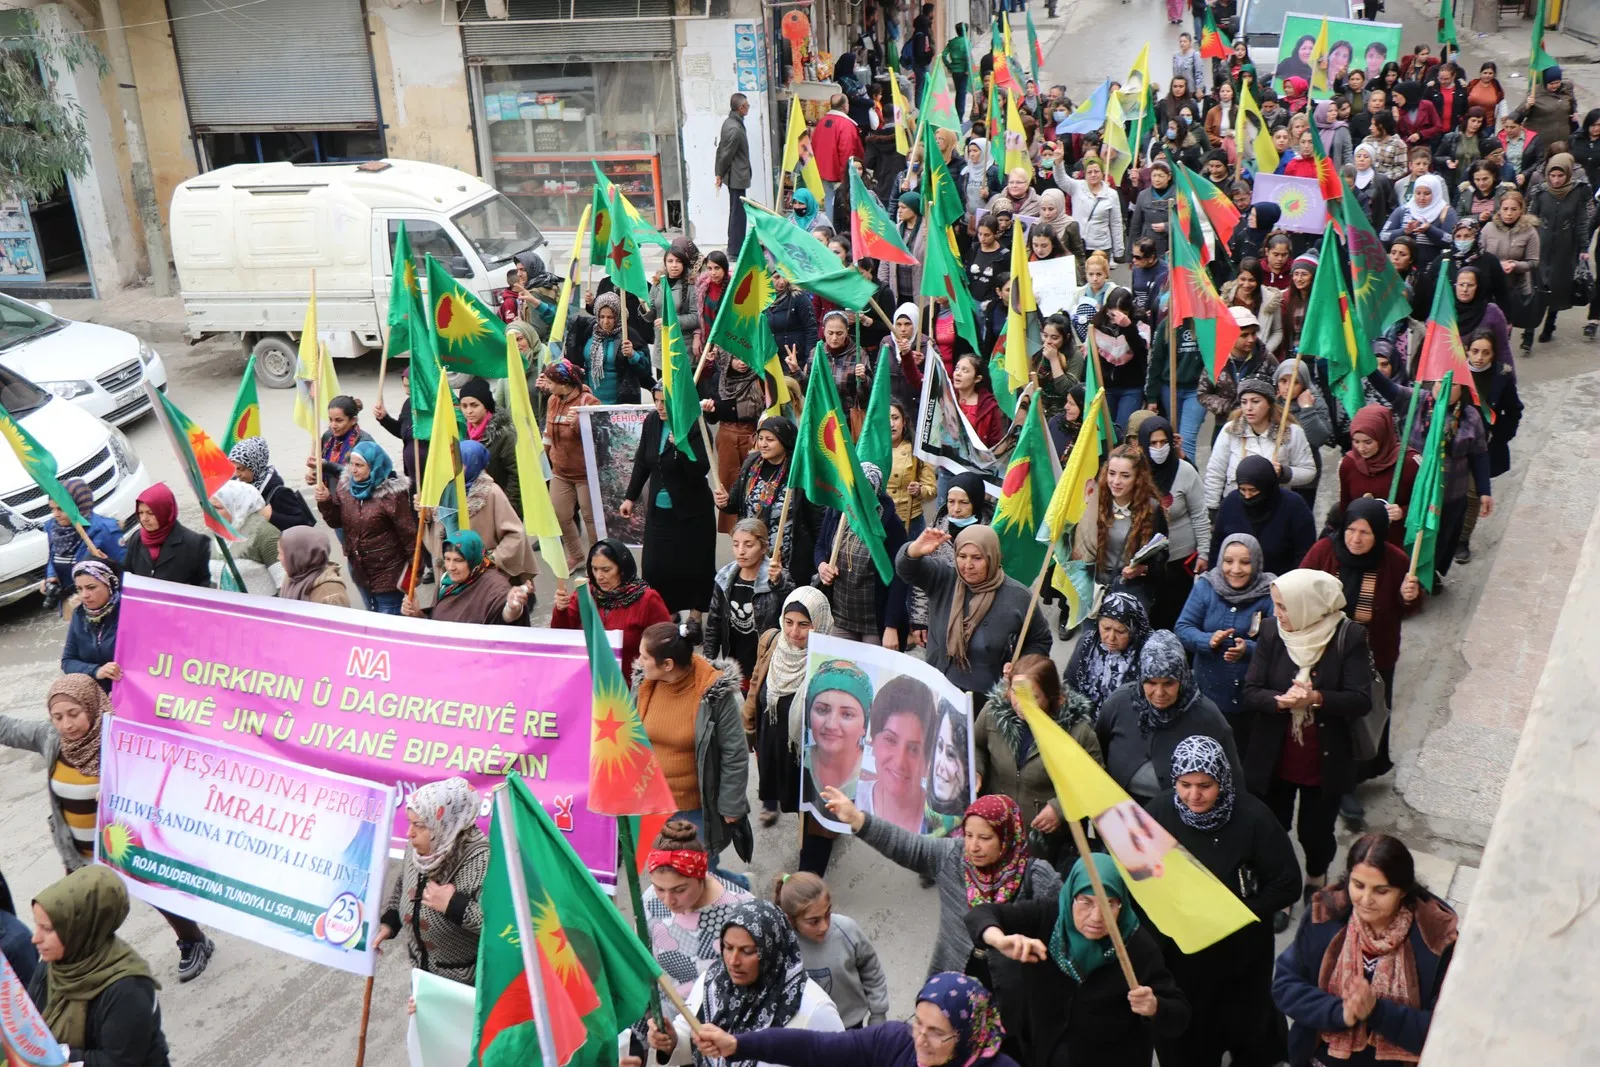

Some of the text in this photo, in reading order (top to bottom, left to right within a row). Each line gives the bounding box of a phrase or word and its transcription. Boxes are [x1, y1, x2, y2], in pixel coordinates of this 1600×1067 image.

[148, 653, 559, 738] JI QIRKIRIN Û DAGIRKERIYÊ RE
[347, 647, 391, 680] NA
[155, 693, 549, 780] EMÊ JIN Û JIYANÊ BIPARÊZIN
[116, 731, 307, 804] HILWEŞANDINA
[312, 786, 383, 823] PERGALA
[204, 783, 317, 841] ÎMRALIYÊ
[108, 794, 221, 842] HILWEŞANDINA
[225, 829, 289, 864] TÛNDIYA
[292, 851, 308, 868] LI
[308, 856, 333, 877] SER
[132, 855, 158, 873] ROJA
[224, 885, 264, 910] TUNDIYA
[265, 901, 276, 913] LI
[276, 902, 294, 919] SER
[292, 909, 316, 926] JINE
[334, 898, 356, 922] 25
